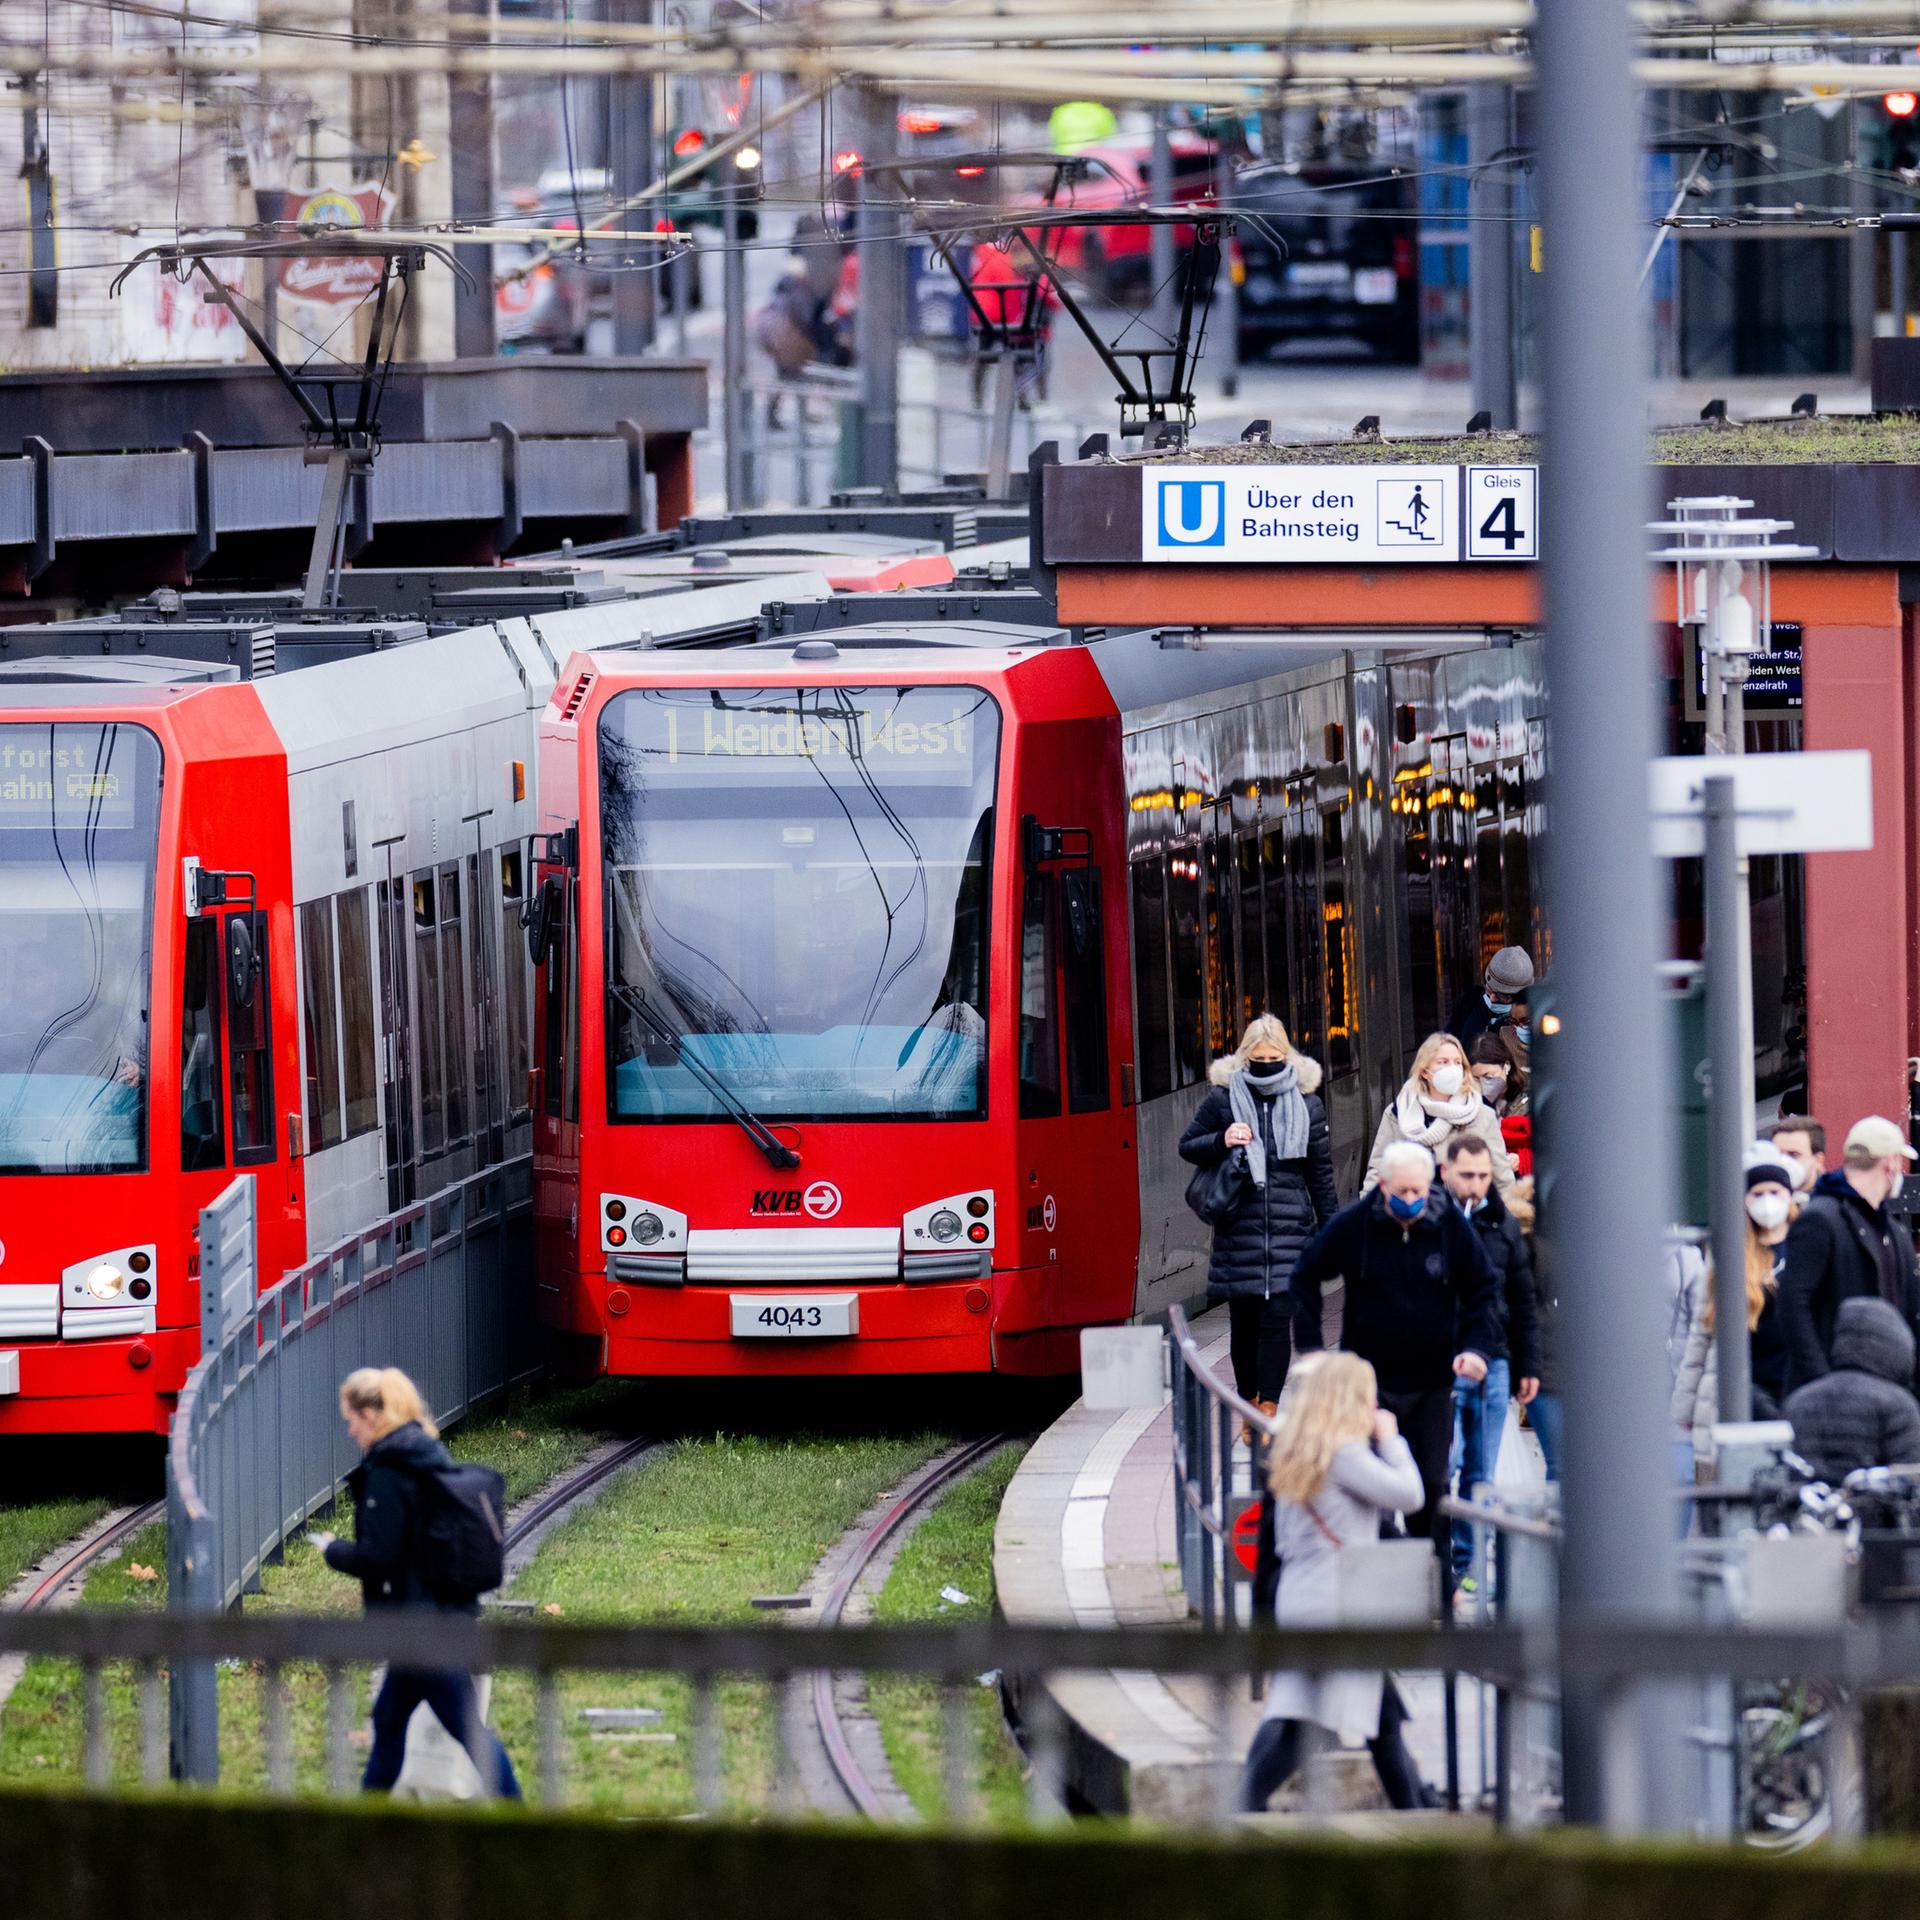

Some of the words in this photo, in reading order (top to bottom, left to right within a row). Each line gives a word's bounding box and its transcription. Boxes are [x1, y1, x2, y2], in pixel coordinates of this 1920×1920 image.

[1483, 475, 1521, 488] Gleis
[1246, 485, 1302, 509] Über
[1311, 490, 1354, 509] den
[1164, 484, 1219, 543] U
[1480, 497, 1525, 550] 4
[1241, 518, 1359, 542] Bahnsteig
[1748, 651, 1781, 660] chener
[1747, 666, 1773, 675] eiden
[1775, 666, 1800, 675] West
[1741, 680, 1788, 690] enzelrath
[663, 708, 678, 763] 1
[703, 709, 847, 757] Weiden
[863, 708, 968, 755] West
[0, 774, 53, 800] ahn
[752, 1191, 802, 1212] KVB
[188, 1255, 200, 1277] KV
[758, 1307, 822, 1326] 4043
[786, 1324, 792, 1334] 1
